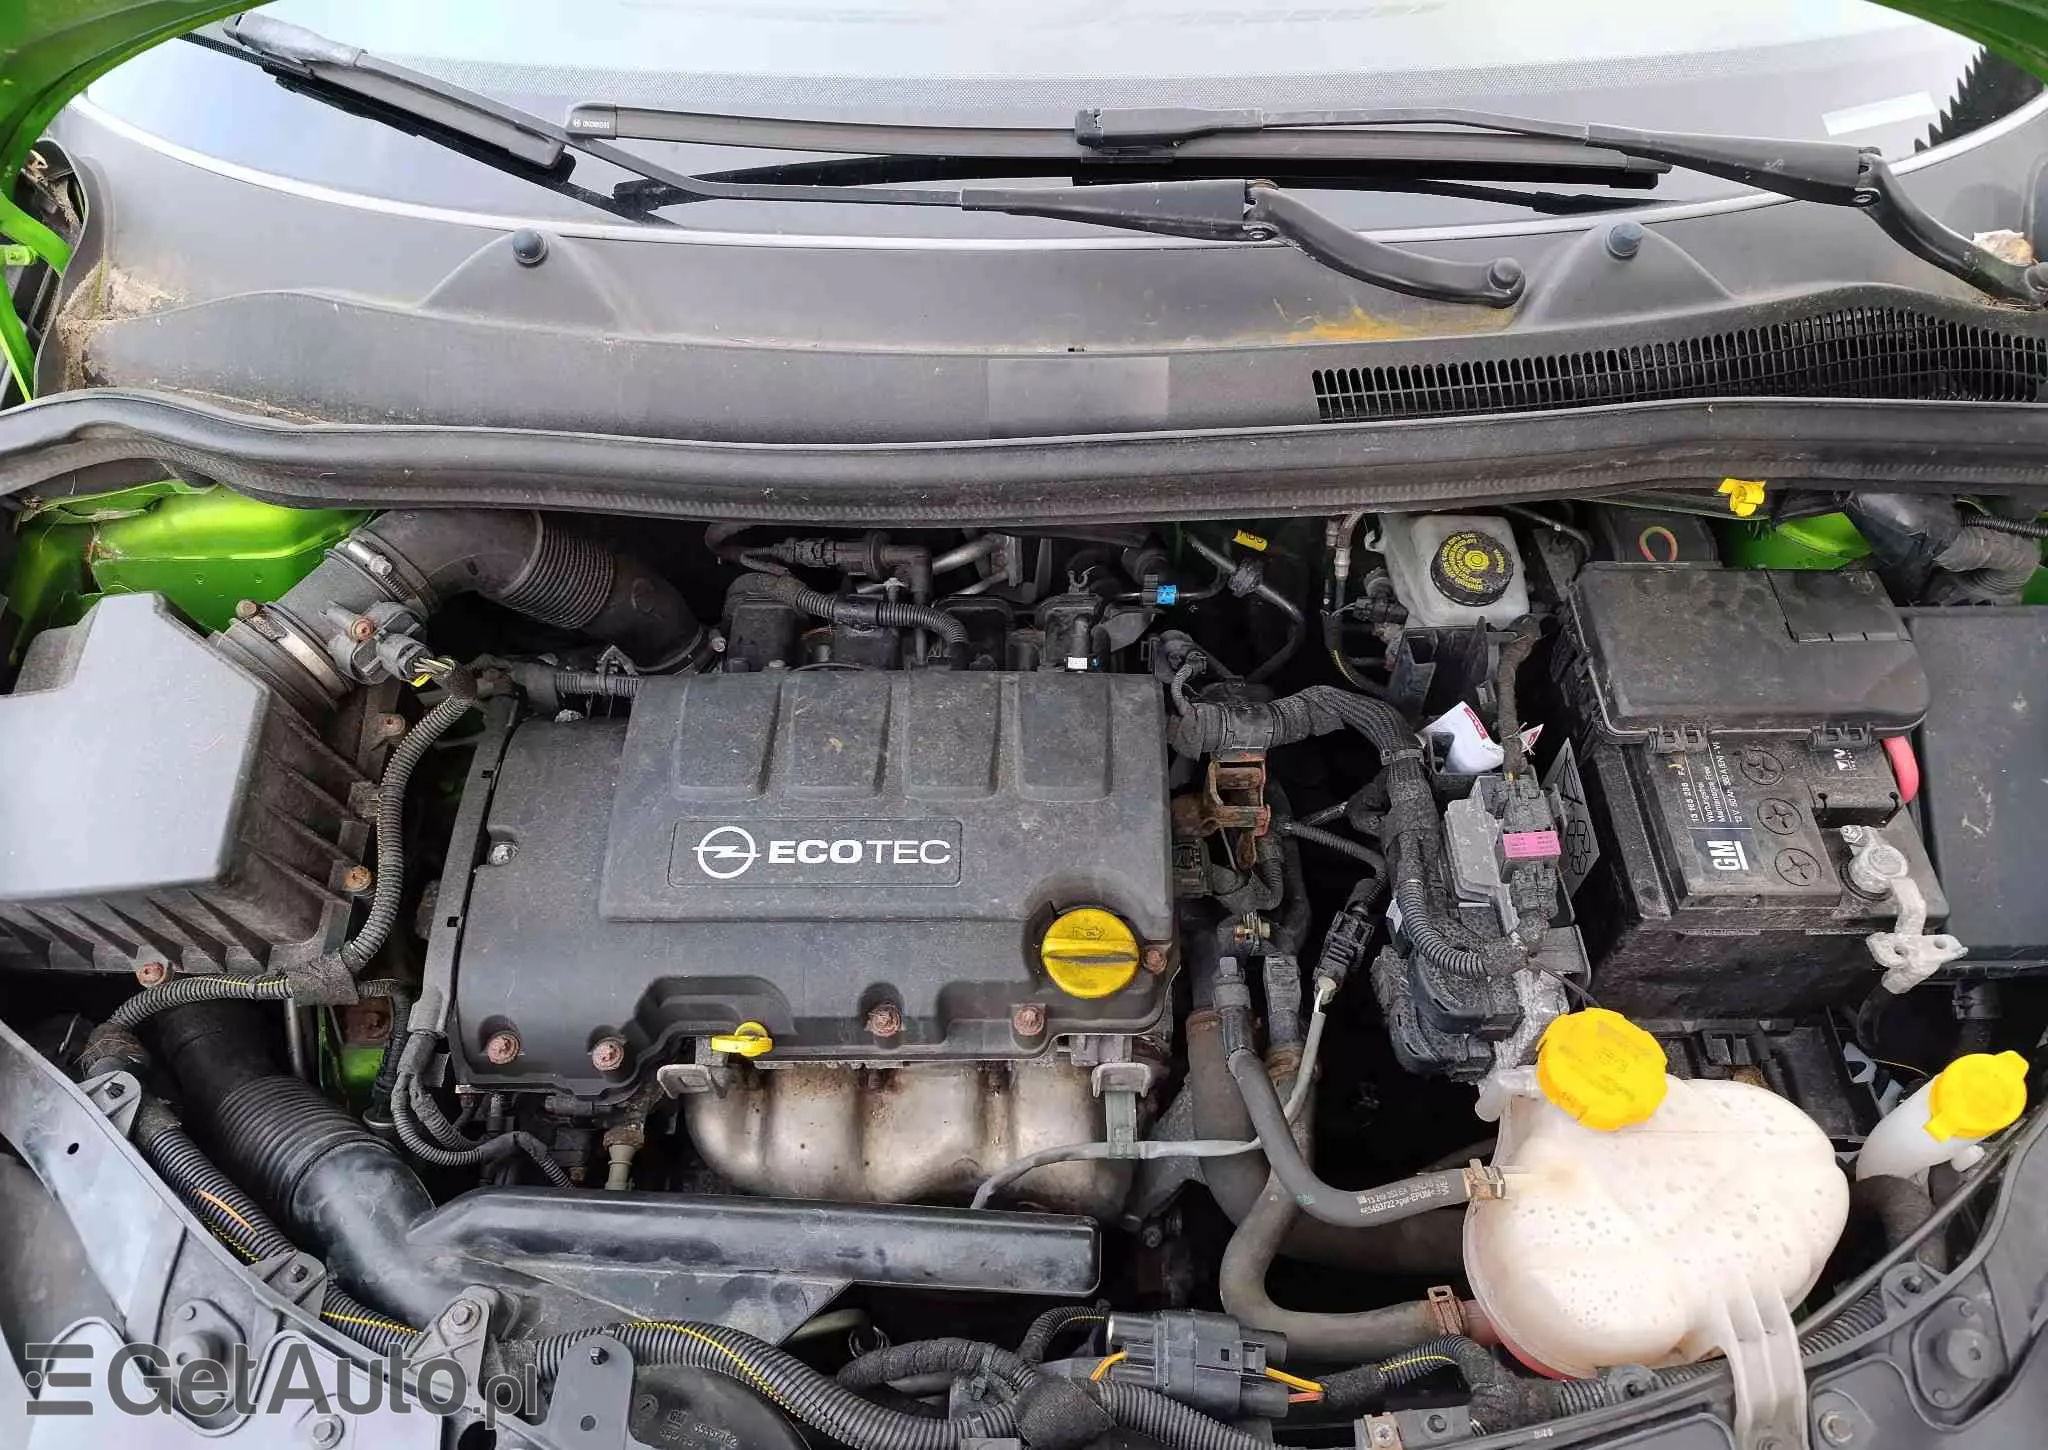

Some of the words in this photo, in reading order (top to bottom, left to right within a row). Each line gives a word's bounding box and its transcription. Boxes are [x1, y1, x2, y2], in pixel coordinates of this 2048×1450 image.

[1709, 781, 1726, 824] Maintenance
[767, 839, 952, 865] ECOTEC
[1706, 840, 1740, 871] GM
